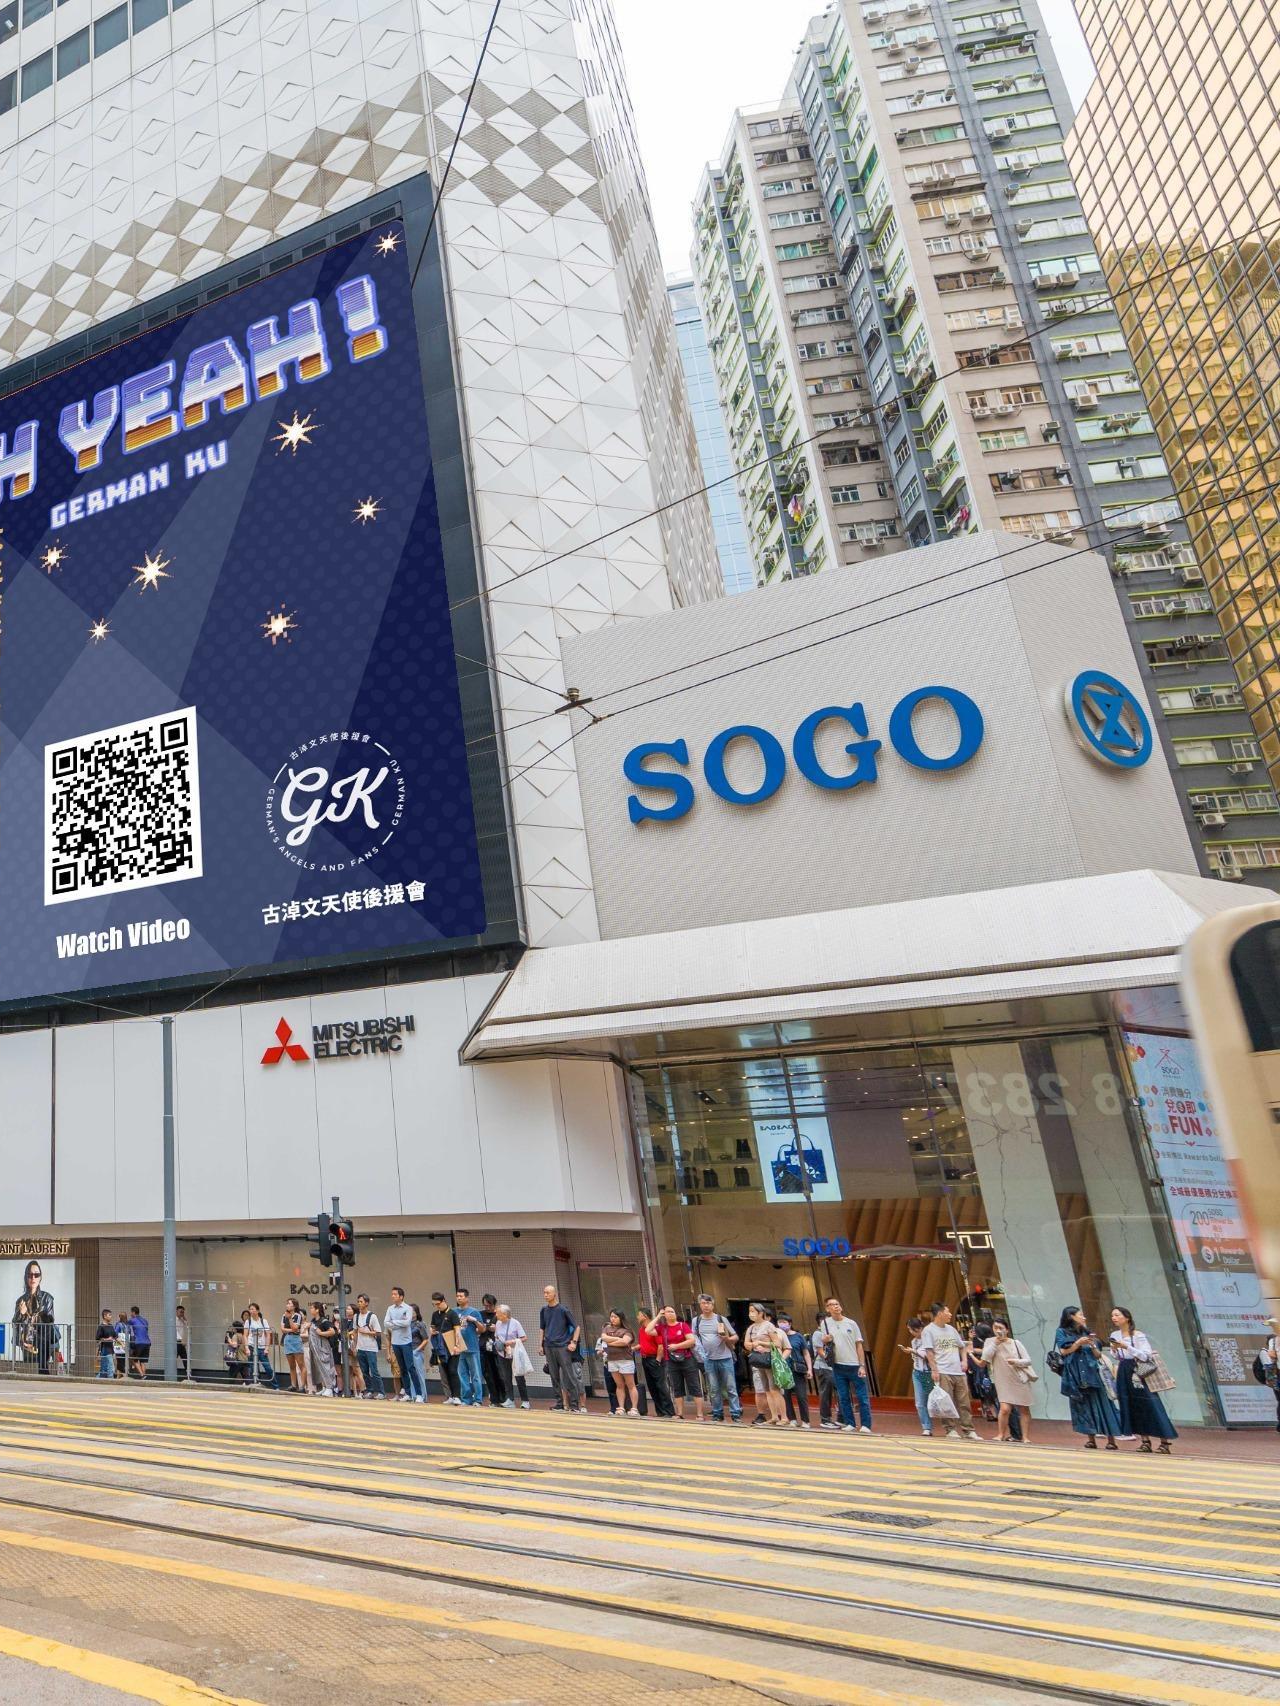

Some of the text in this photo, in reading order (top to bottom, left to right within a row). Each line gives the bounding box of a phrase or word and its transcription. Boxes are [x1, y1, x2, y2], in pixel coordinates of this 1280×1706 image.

[50, 440, 228, 529] GERMAN KU
[623, 685, 984, 825] SOGO
[390, 759, 406, 826] GERMAN KU
[265, 788, 380, 872] GERMAN'S ANGELS AND FANS
[262, 880, 426, 925] 古淖文天使後援會
[56, 918, 190, 958] Watch Video
[312, 1015, 415, 1041] MITSUBISHI
[314, 1034, 403, 1059] ELECTRIC
[1168, 1115, 1203, 1136] FUN
[23, 1243, 69, 1254] LAURENT
